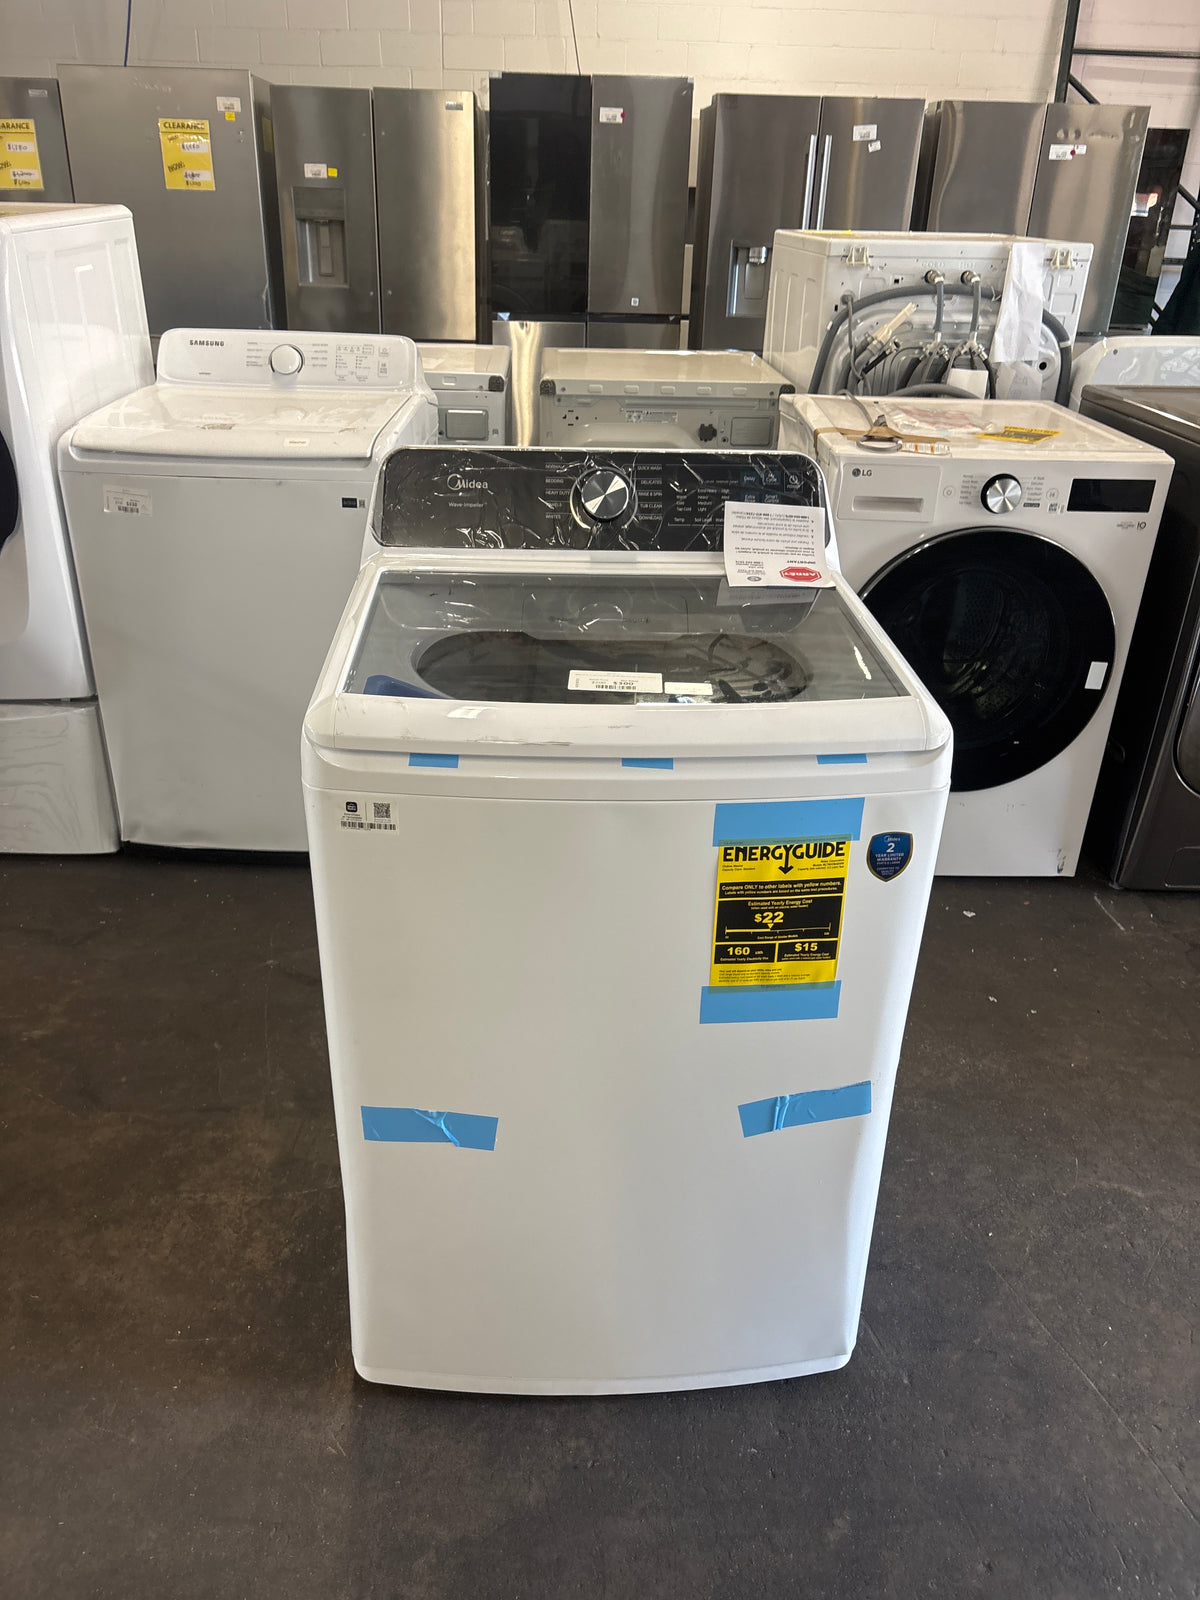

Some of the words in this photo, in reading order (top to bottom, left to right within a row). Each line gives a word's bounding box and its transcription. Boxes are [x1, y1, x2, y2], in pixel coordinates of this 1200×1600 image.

[163, 121, 205, 130] CLEARANCE
[862, 469, 872, 477] LG
[446, 474, 488, 490] Midea
[722, 841, 846, 862] ENERGYGUIDE
[886, 842, 895, 852] 2
[754, 912, 784, 923] $22
[728, 947, 750, 955] 160
[794, 943, 818, 952] $15
